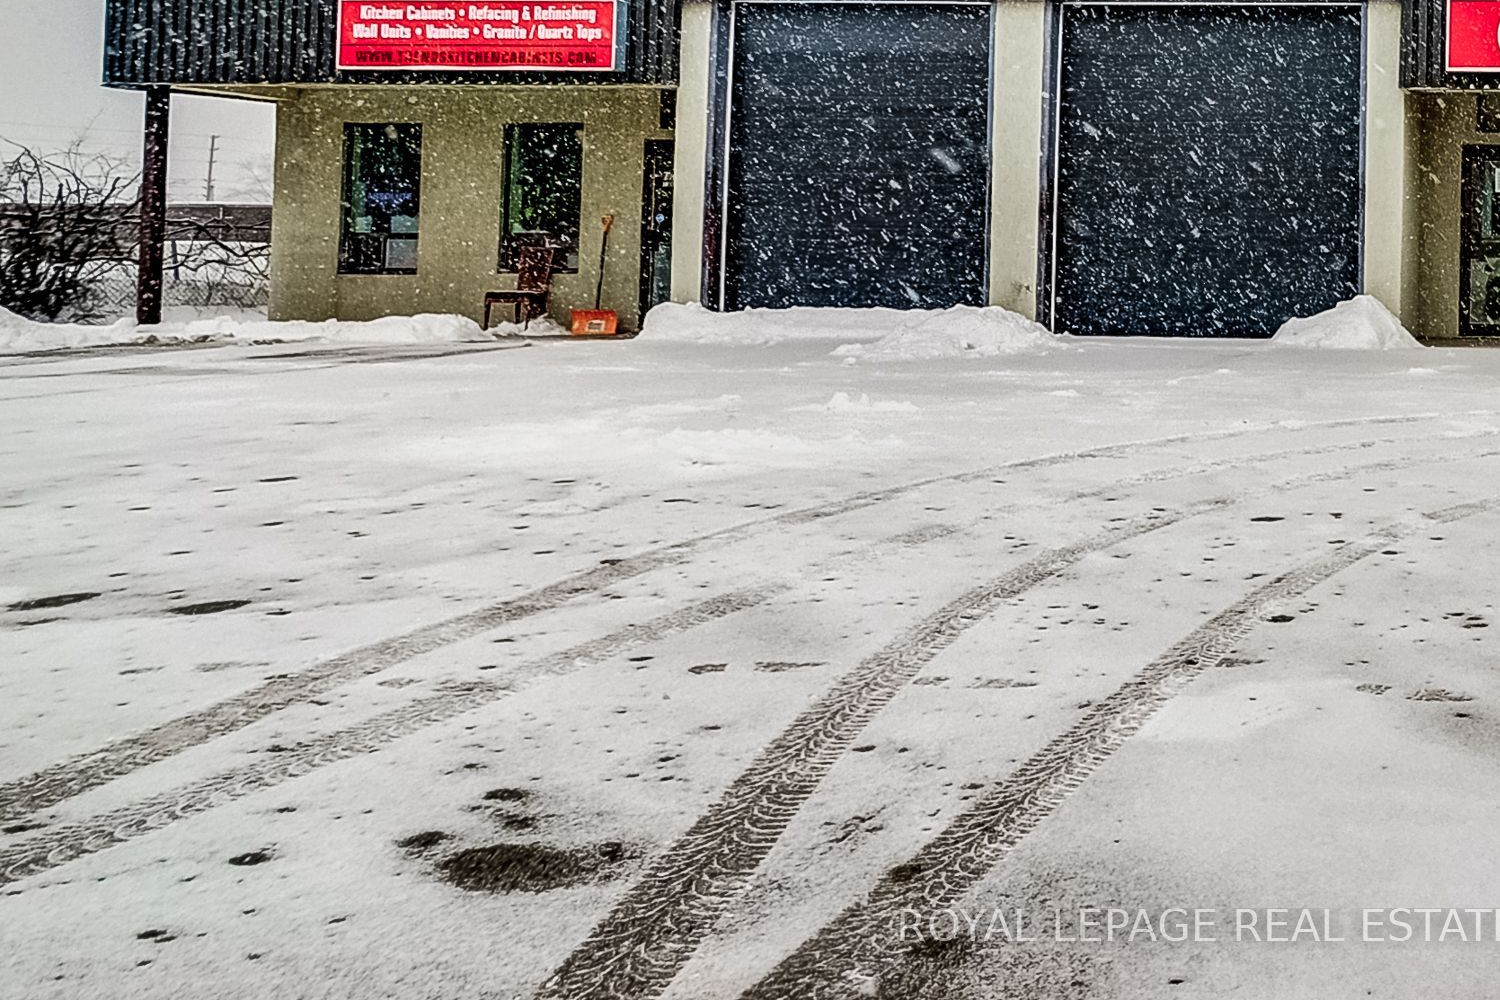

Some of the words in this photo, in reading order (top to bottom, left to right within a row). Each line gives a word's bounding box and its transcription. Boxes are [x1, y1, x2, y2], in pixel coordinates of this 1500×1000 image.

[360, 5, 404, 20] Kitchen
[406, 5, 456, 20] Cabinets
[468, 5, 519, 23] Refacing
[521, 5, 532, 20] &
[533, 5, 597, 23] Refinishing
[352, 23, 379, 39] Wall
[380, 23, 412, 39] Units
[425, 23, 470, 39] Vanities
[483, 23, 527, 40] Granite
[537, 24, 574, 39] Quartz
[576, 23, 602, 42] Tops
